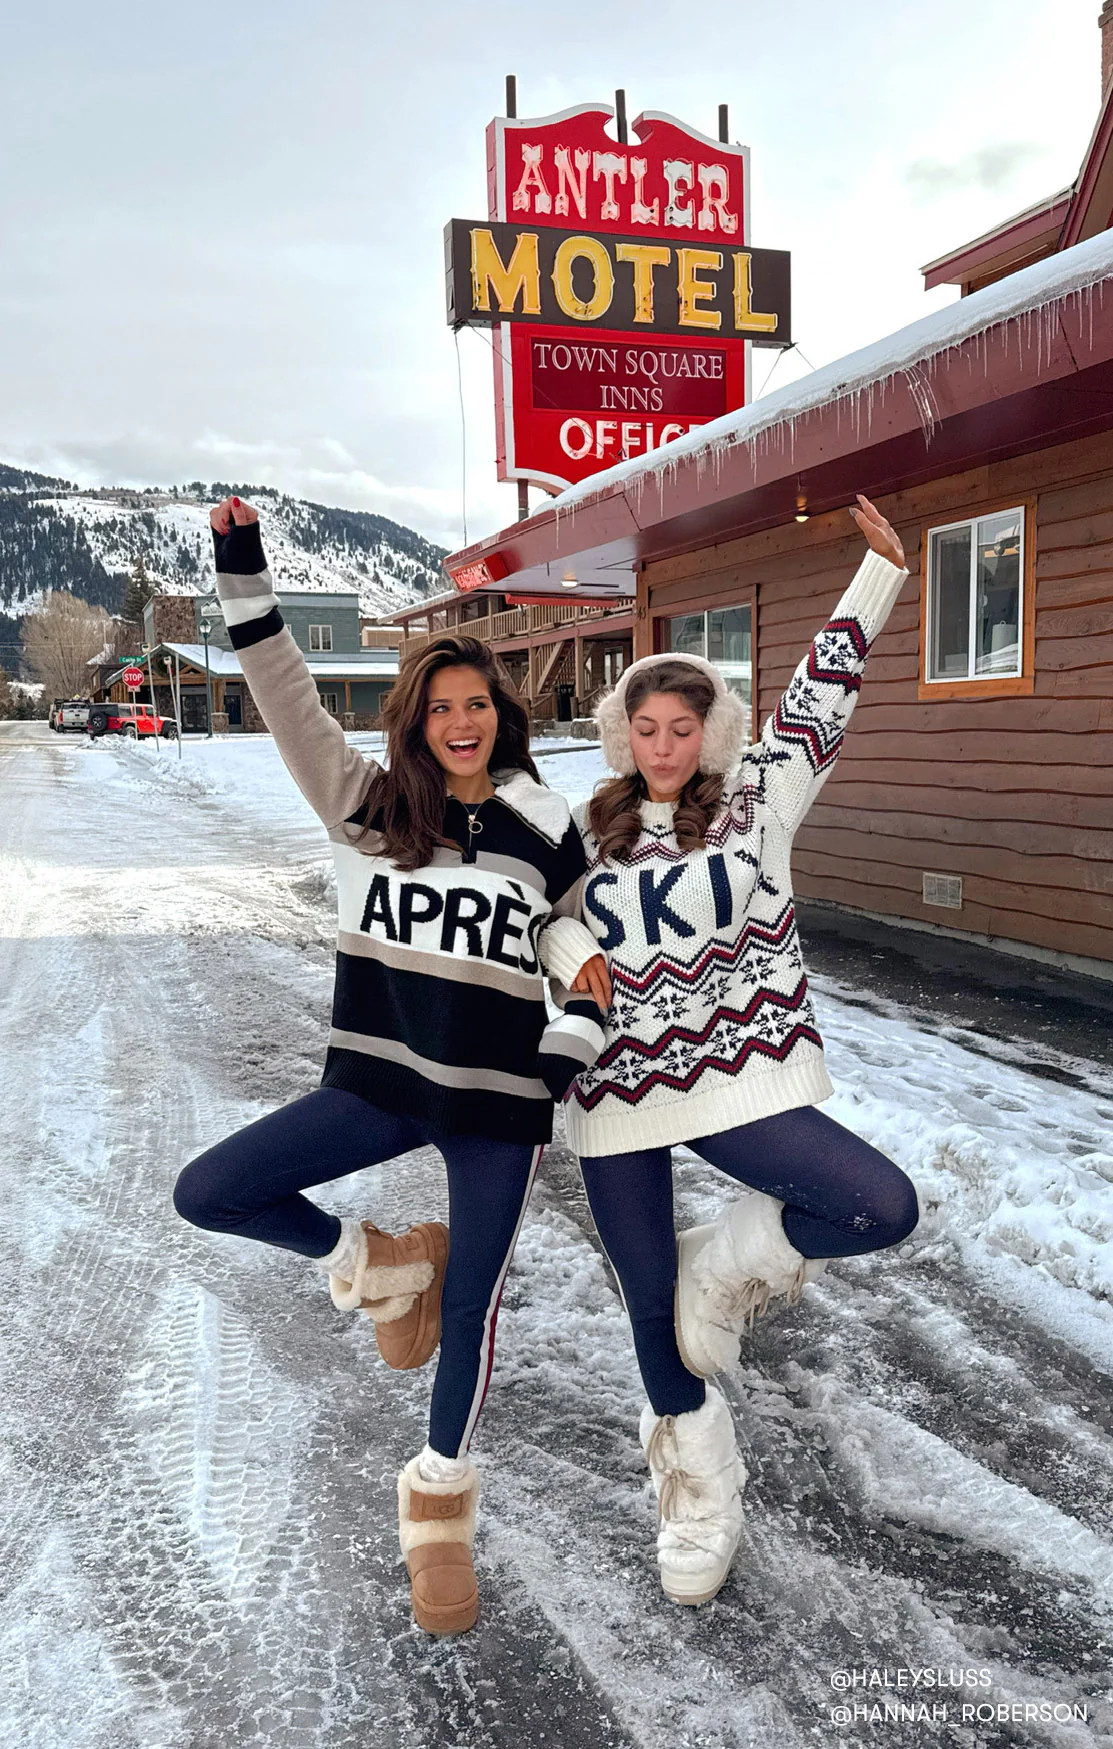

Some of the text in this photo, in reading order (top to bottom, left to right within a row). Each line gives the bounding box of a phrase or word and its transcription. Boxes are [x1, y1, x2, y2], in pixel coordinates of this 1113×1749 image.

[512, 143, 738, 234] ANTLER
[470, 228, 778, 332] MOTEL
[534, 343, 724, 384] TOWN SQUARE
[600, 385, 663, 411] INNS
[559, 417, 704, 460] OFFIC
[124, 673, 142, 682] STOP
[360, 873, 547, 975] APRÈS
[585, 853, 732, 951] SKI
